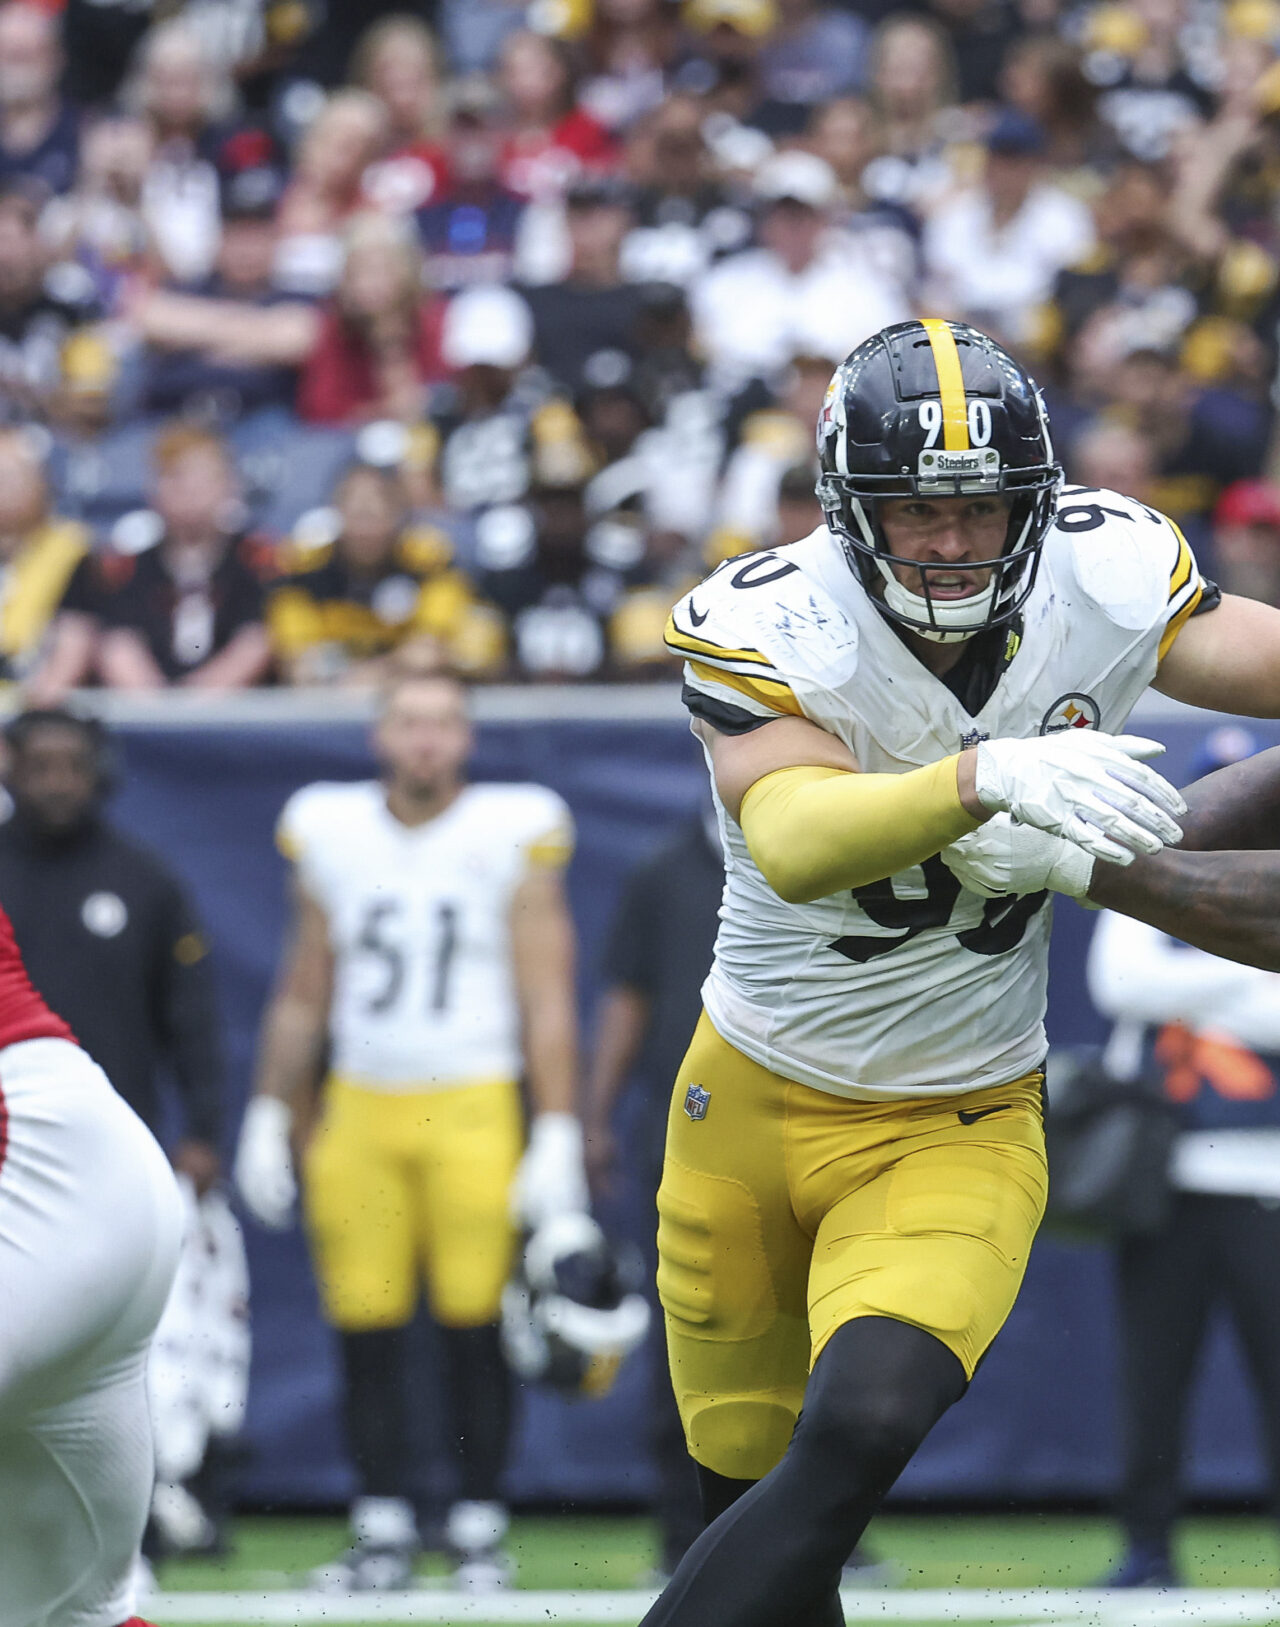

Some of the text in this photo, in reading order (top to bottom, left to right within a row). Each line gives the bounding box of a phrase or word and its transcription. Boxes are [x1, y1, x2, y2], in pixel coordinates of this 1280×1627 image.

[918, 400, 992, 449] 90
[937, 454, 980, 470] Steelers
[357, 898, 459, 1018] 51
